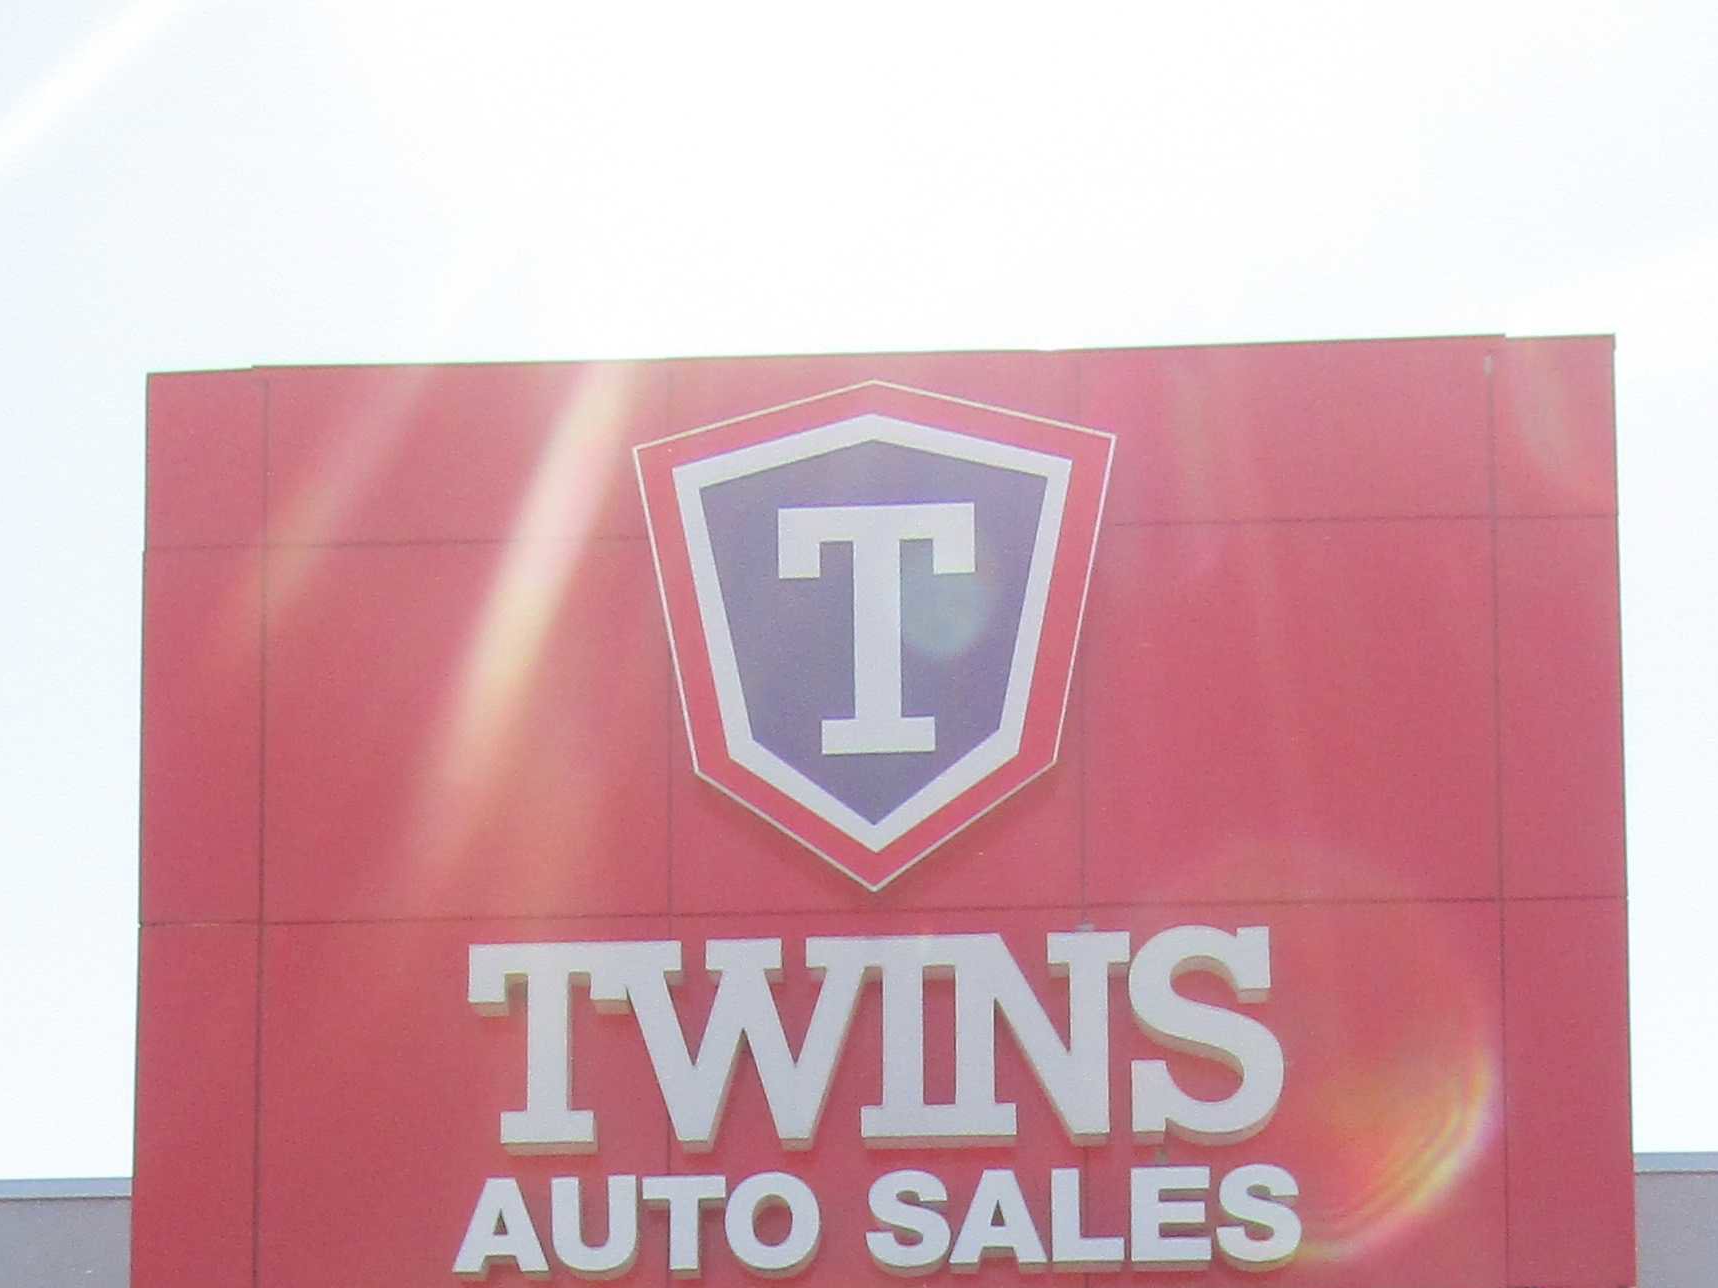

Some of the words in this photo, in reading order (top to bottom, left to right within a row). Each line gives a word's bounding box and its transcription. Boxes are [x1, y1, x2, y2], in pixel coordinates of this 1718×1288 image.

[778, 502, 976, 755] T
[467, 924, 1285, 1153] TWINS
[451, 1171, 821, 1279] AUTO
[864, 1163, 1302, 1274] SALES
